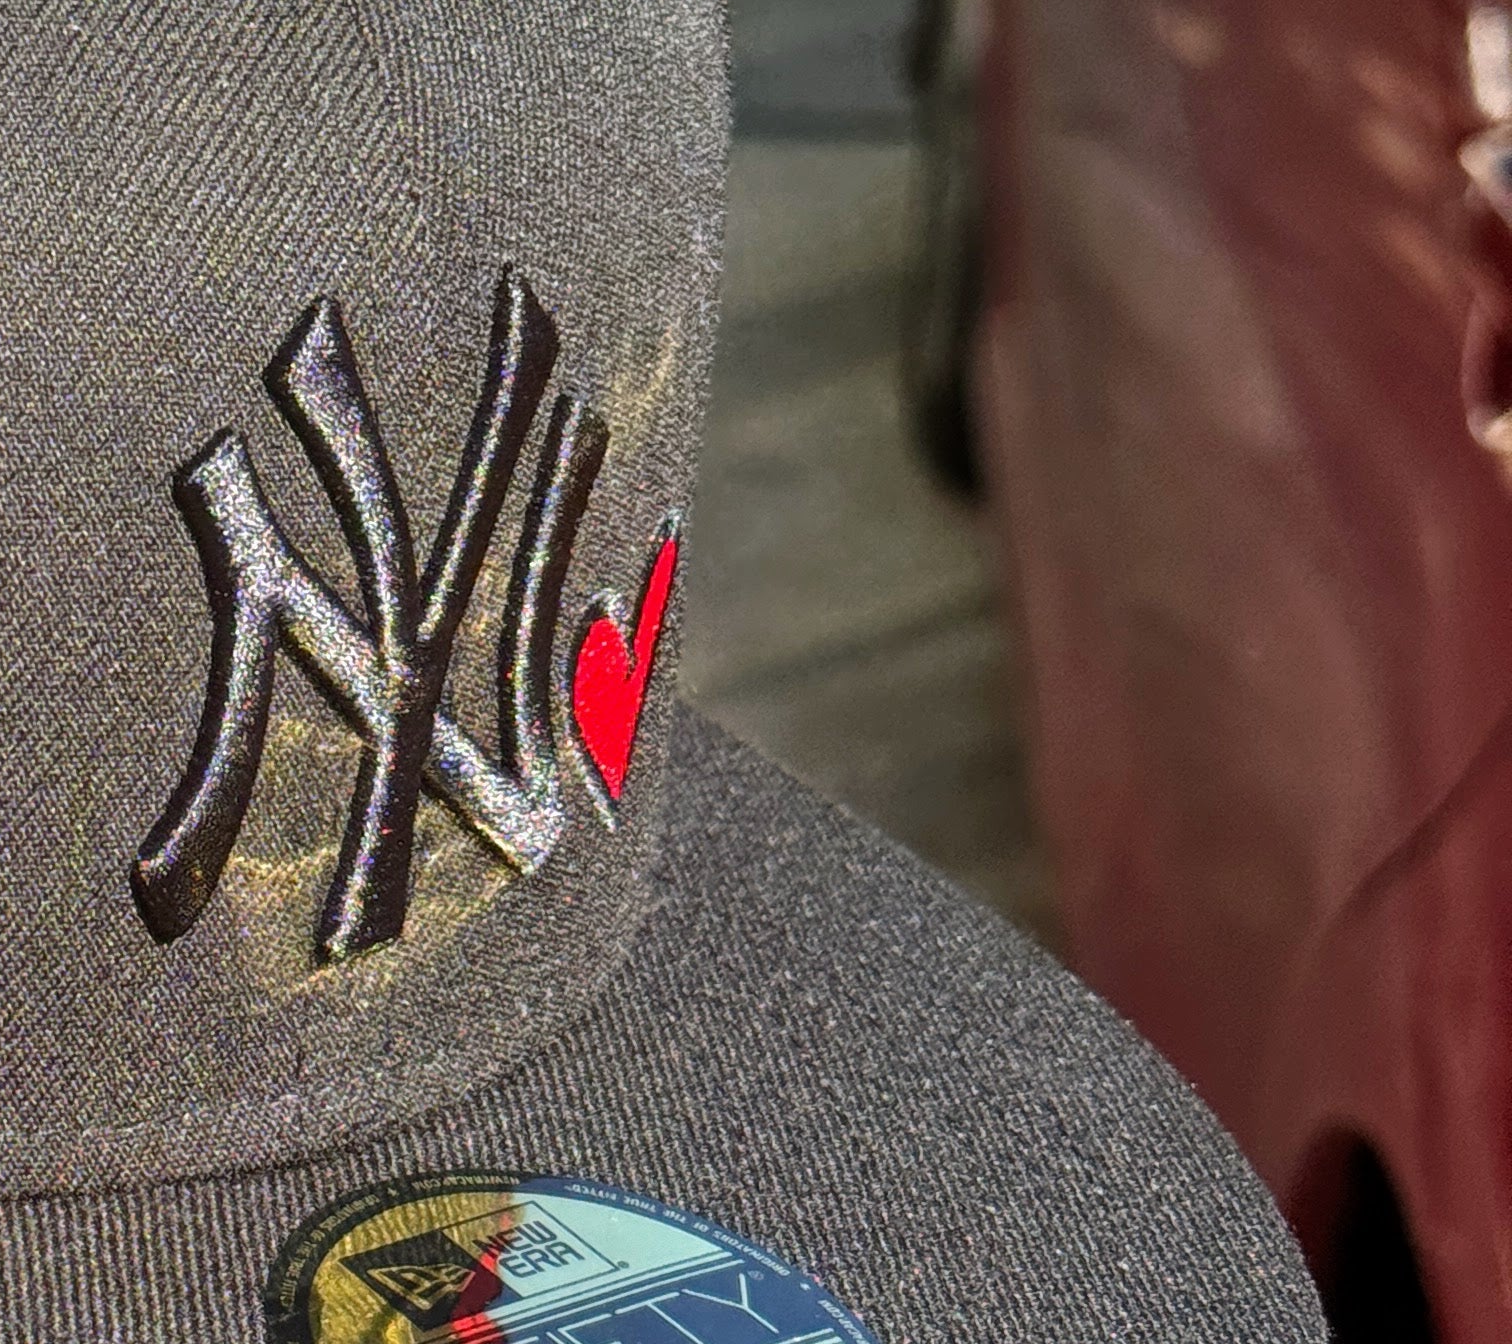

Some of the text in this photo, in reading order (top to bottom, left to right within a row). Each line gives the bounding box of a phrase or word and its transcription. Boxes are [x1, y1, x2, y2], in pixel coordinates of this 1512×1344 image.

[130, 261, 610, 964] NY
[472, 1220, 558, 1260] NEW
[498, 1242, 586, 1279] ERA
